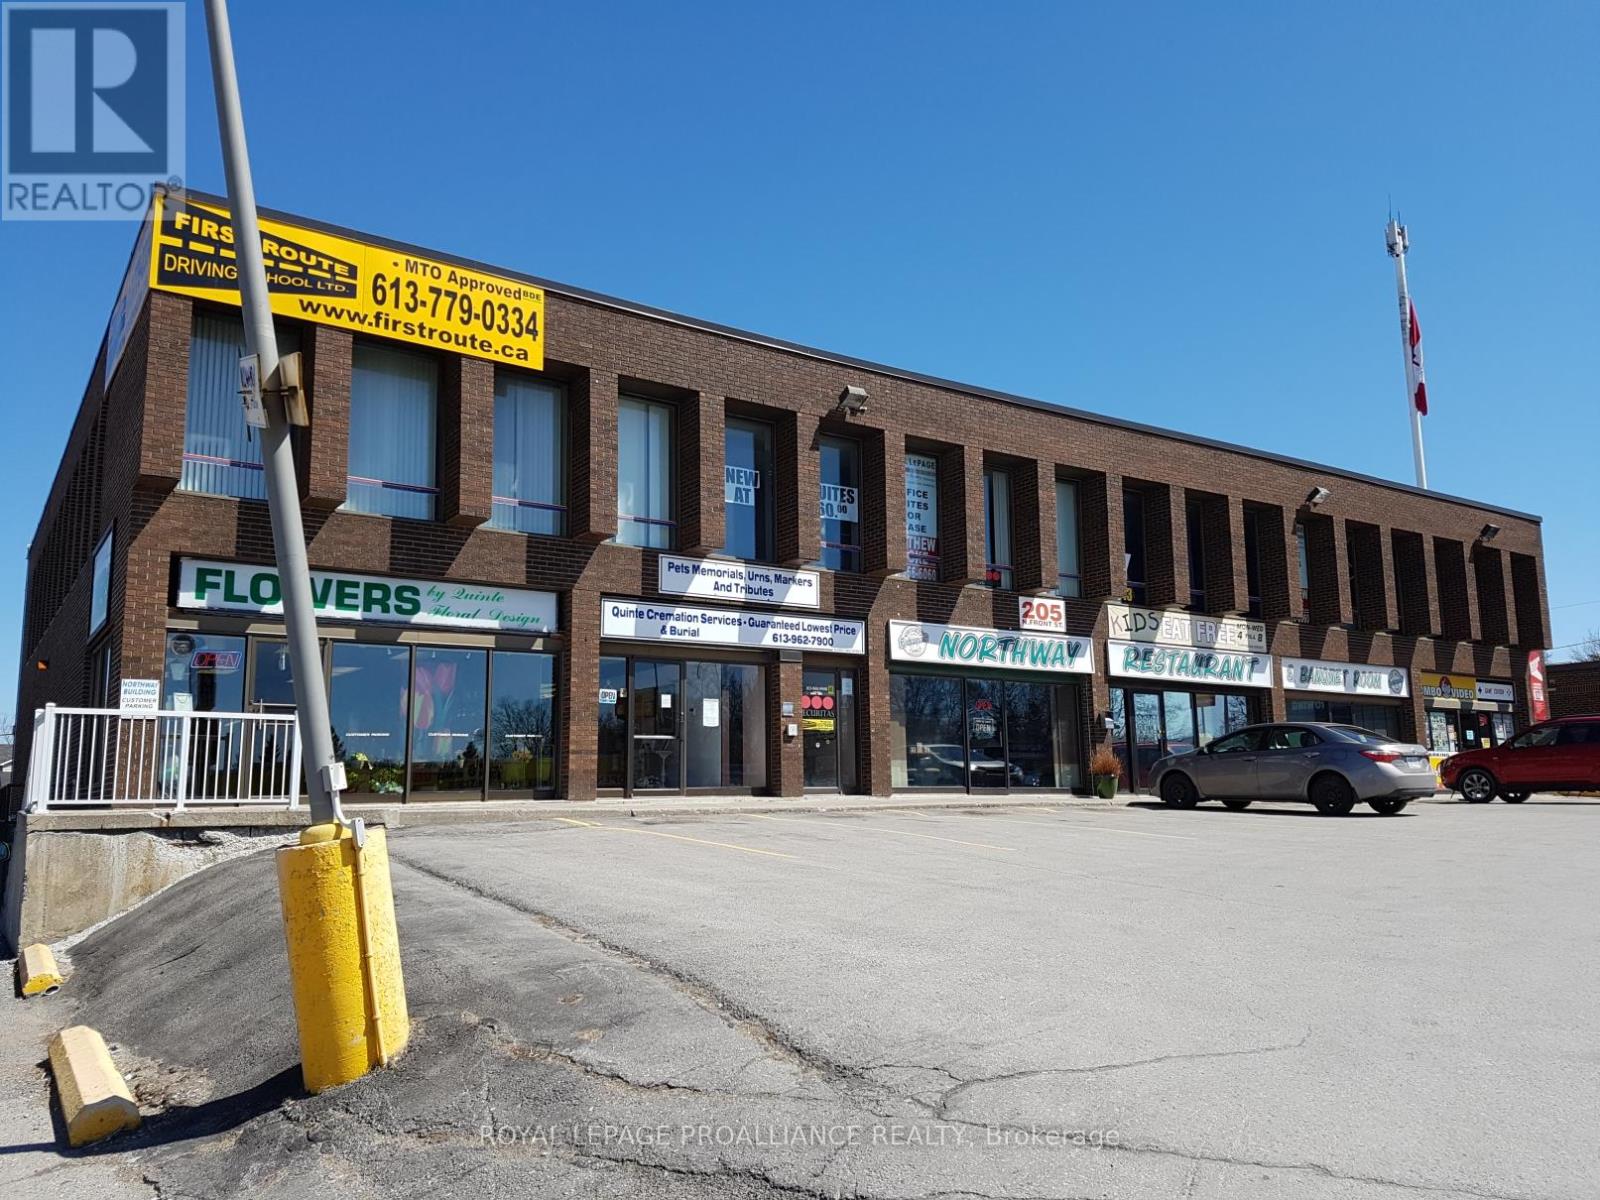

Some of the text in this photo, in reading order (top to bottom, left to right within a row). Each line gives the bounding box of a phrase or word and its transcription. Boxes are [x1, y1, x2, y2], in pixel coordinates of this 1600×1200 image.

[175, 211, 350, 277] FIRS ROUTE
[164, 253, 350, 293] DRIVING HOOL LTD.
[405, 259, 442, 280] MTO
[447, 270, 522, 301] Approved
[371, 272, 539, 342] 613-779-0334
[299, 299, 529, 362] www.firstroute.ca
[734, 487, 752, 504] AT
[820, 484, 855, 505] UITES
[906, 488, 929, 500] FICE
[906, 500, 929, 511] ITES
[907, 511, 921, 521] OR
[908, 523, 927, 534] ASE
[907, 536, 936, 552] THEW
[667, 562, 690, 575] Pets
[747, 570, 773, 585] Urns,
[774, 573, 813, 588] Markers
[426, 585, 505, 603] by Quinte
[713, 581, 774, 597] And Tributes
[428, 604, 541, 629] Floral Design
[1021, 601, 1063, 622] 205
[612, 606, 857, 636] Quinte Cremation Services Guaranteed Lowest Price
[1110, 611, 1237, 646] KIDS EAT FREE
[660, 625, 700, 638] & Burial
[772, 633, 834, 647] 613-962-7900
[938, 630, 1082, 669] NORTHWAY
[194, 652, 239, 667] OPEN
[1122, 644, 1260, 682] RESTAURANT
[122, 680, 158, 689] NORTHWAY
[1451, 687, 1474, 699] VIDEO
[600, 690, 616, 700] OPEN
[802, 709, 835, 718] ECURITAS
[976, 723, 992, 732] OPEN
